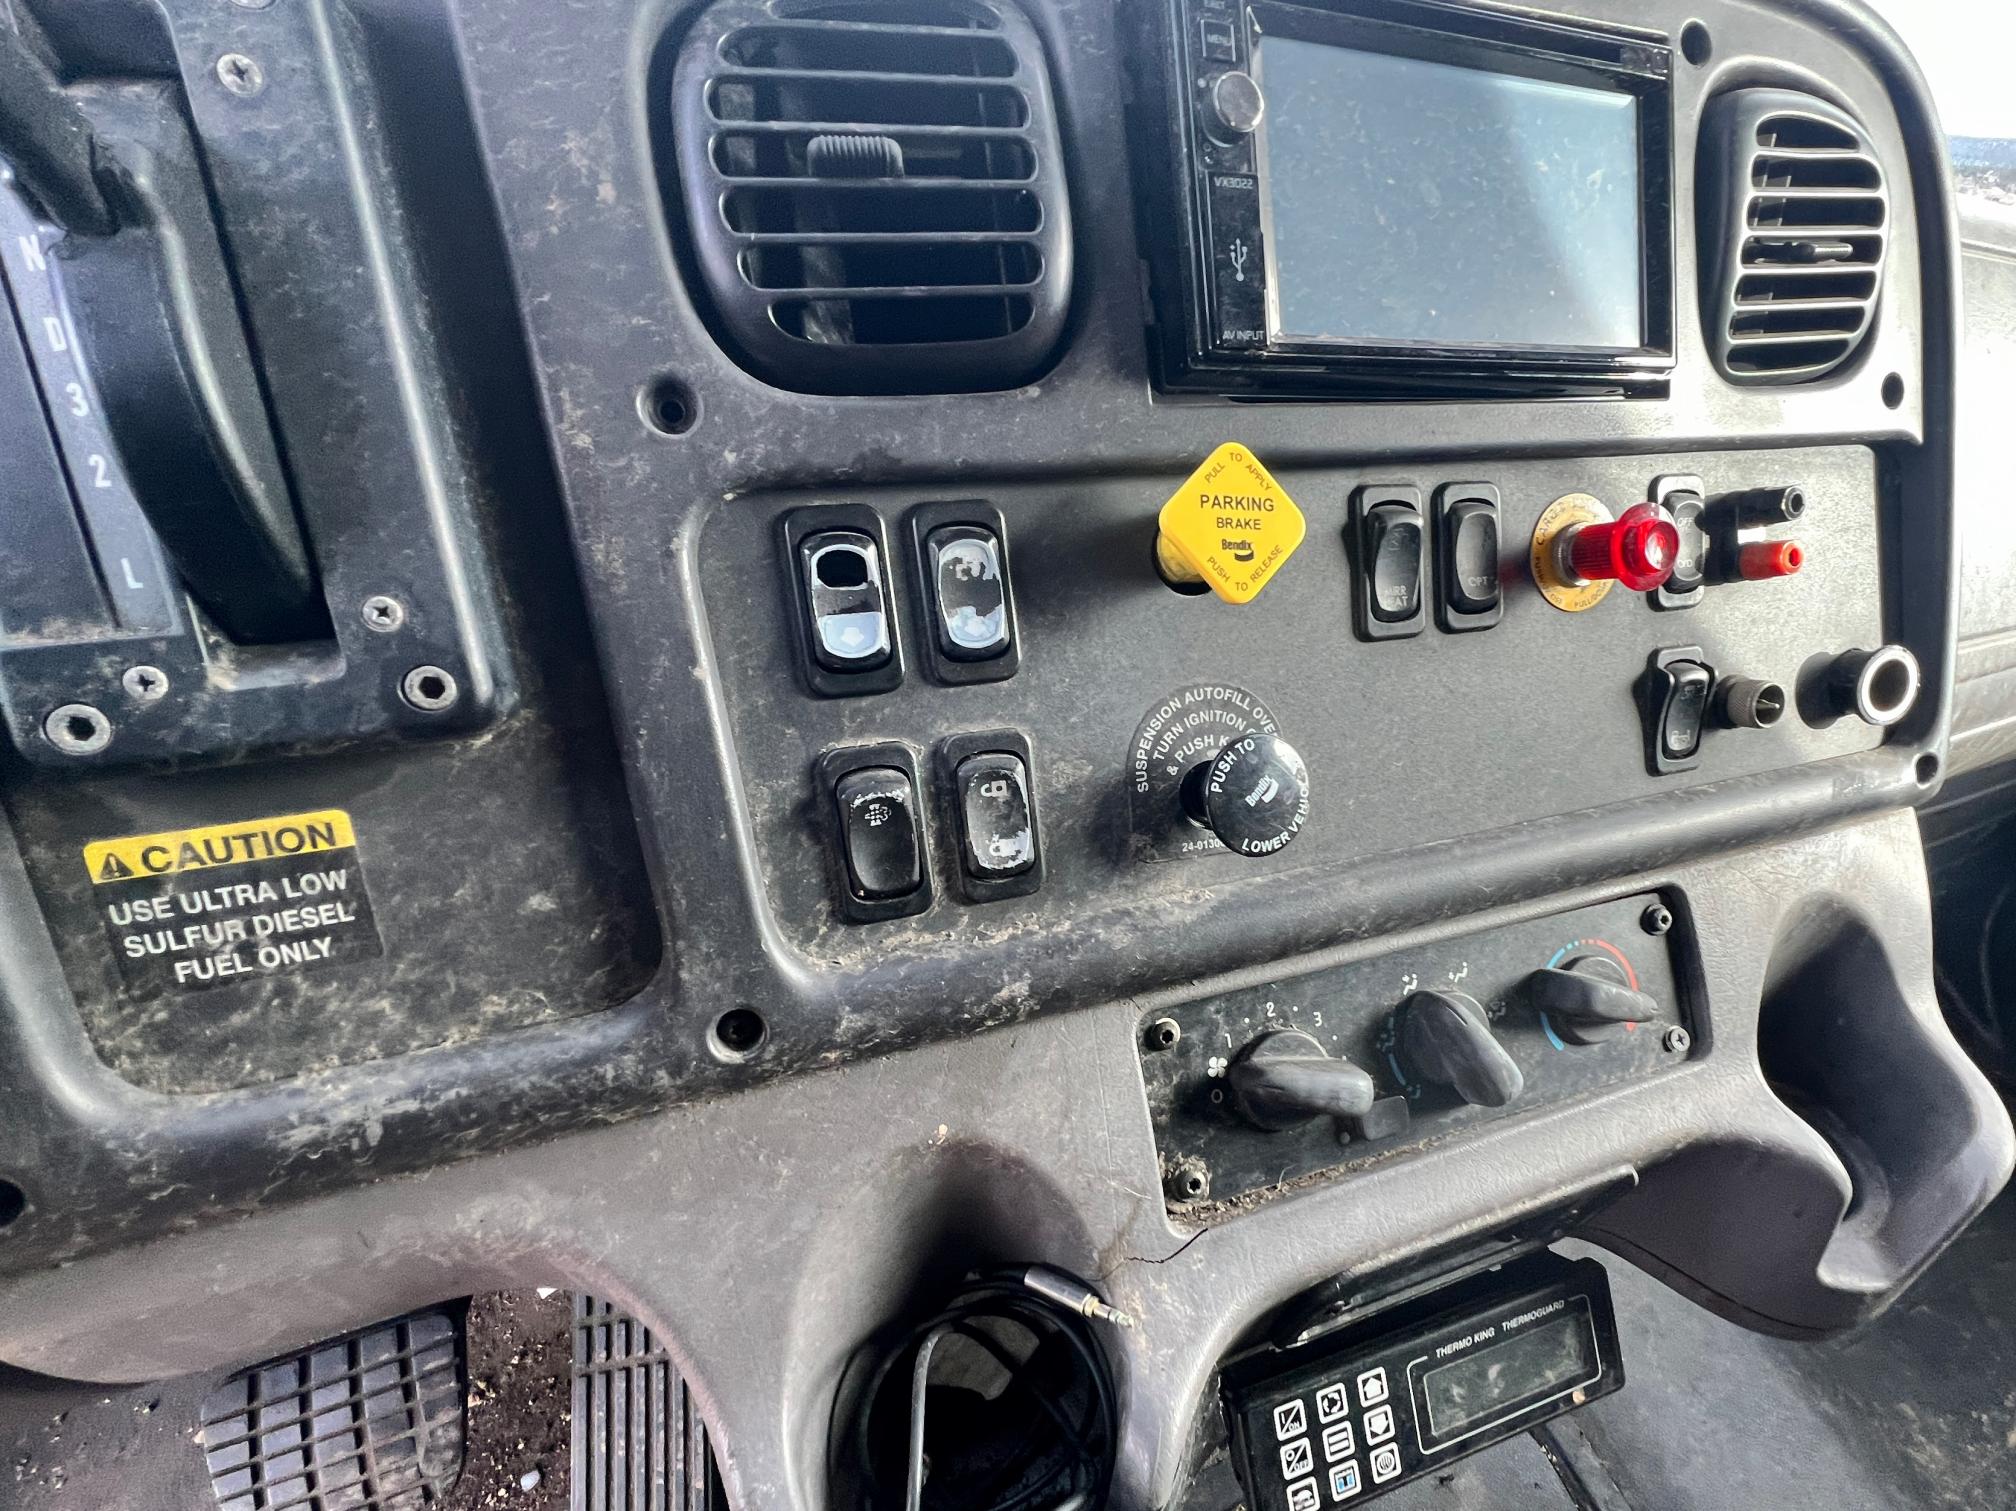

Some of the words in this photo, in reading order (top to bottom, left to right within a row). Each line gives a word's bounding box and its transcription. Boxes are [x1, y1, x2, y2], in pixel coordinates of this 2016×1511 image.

[1213, 177, 1254, 189] VX3022
[19, 234, 46, 271] N
[43, 316, 67, 351] D
[1222, 330, 1236, 341] AV
[1236, 330, 1265, 341] INPUT
[66, 382, 89, 417] 3
[88, 454, 111, 487] 2
[1204, 463, 1225, 484] PULL
[1229, 452, 1243, 462] TO
[1246, 464, 1272, 491] APPLY
[1200, 495, 1275, 512] PARKING
[1216, 516, 1262, 530] BRAKE
[1221, 538, 1252, 551] Bendix
[120, 557, 143, 589] L
[1207, 556, 1231, 583] PUSH
[1235, 582, 1248, 592] TO
[1250, 545, 1283, 583] RELEASE
[1135, 698, 1182, 793] SUSPENSION
[1184, 687, 1251, 711] AUTOFILL
[1153, 723, 1184, 761] TURN
[1184, 709, 1247, 735] IGNITION
[1166, 765, 1179, 777] &
[1174, 734, 1215, 764] PUSH
[1210, 751, 1237, 793] PUSH
[1235, 738, 1255, 755] TO
[141, 822, 337, 873] CAUTION
[1241, 831, 1291, 853] LOWER
[108, 896, 175, 925] USE
[178, 880, 279, 915] ULTRA
[281, 868, 348, 899] LOW
[123, 919, 246, 957] SULFUR
[252, 902, 356, 938] DIESEL
[173, 952, 254, 984] FUEL
[257, 936, 332, 968] ONLY
[1266, 1002, 1276, 1017] 2
[1313, 1011, 1322, 1027] 3
[1225, 1033, 1232, 1048] 1
[1435, 1335, 1473, 1359] THERMO
[1473, 1326, 1496, 1344] KING
[1501, 1299, 1566, 1332] THERMOGUARD
[1288, 1420, 1300, 1431] ON
